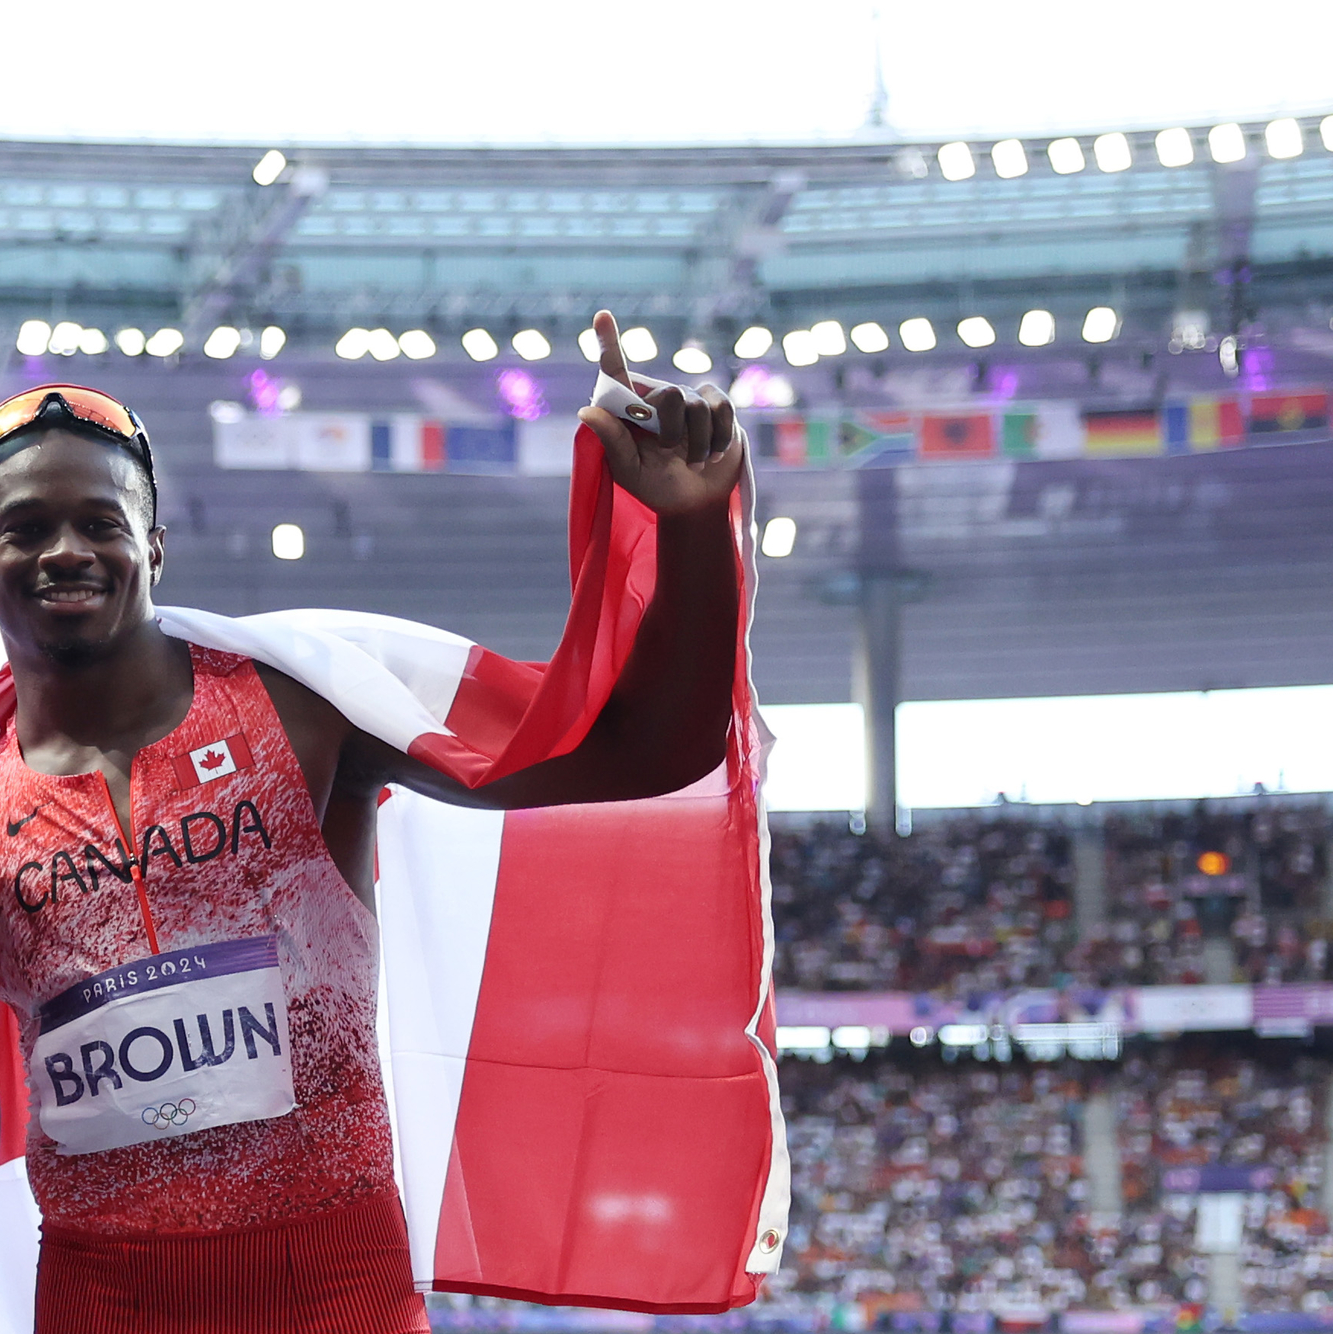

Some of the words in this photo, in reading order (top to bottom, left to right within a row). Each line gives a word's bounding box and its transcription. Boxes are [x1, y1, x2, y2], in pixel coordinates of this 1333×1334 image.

[14, 800, 272, 913] CANADA
[146, 955, 207, 981] 2024
[45, 1002, 282, 1107] BROWN
